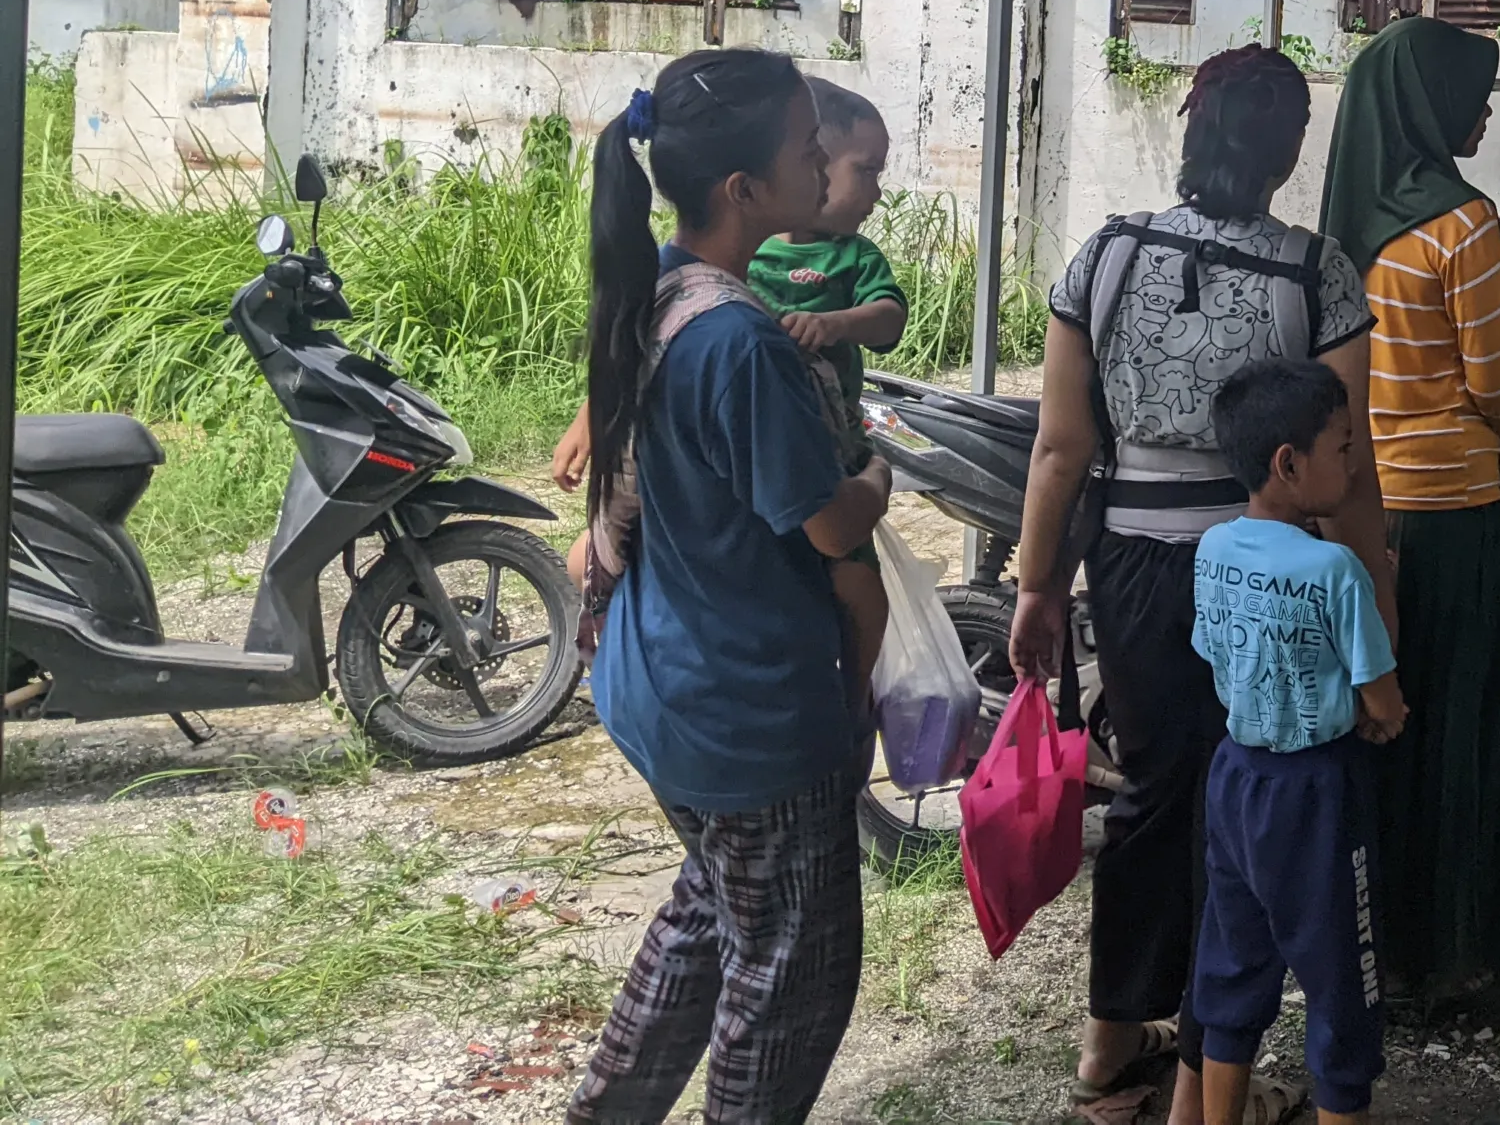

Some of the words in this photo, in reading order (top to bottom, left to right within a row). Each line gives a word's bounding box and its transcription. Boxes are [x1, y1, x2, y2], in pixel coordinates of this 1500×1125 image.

[366, 450, 417, 473] HONDA
[1247, 571, 1328, 608] GAME
[1360, 949, 1380, 1009] ONE
